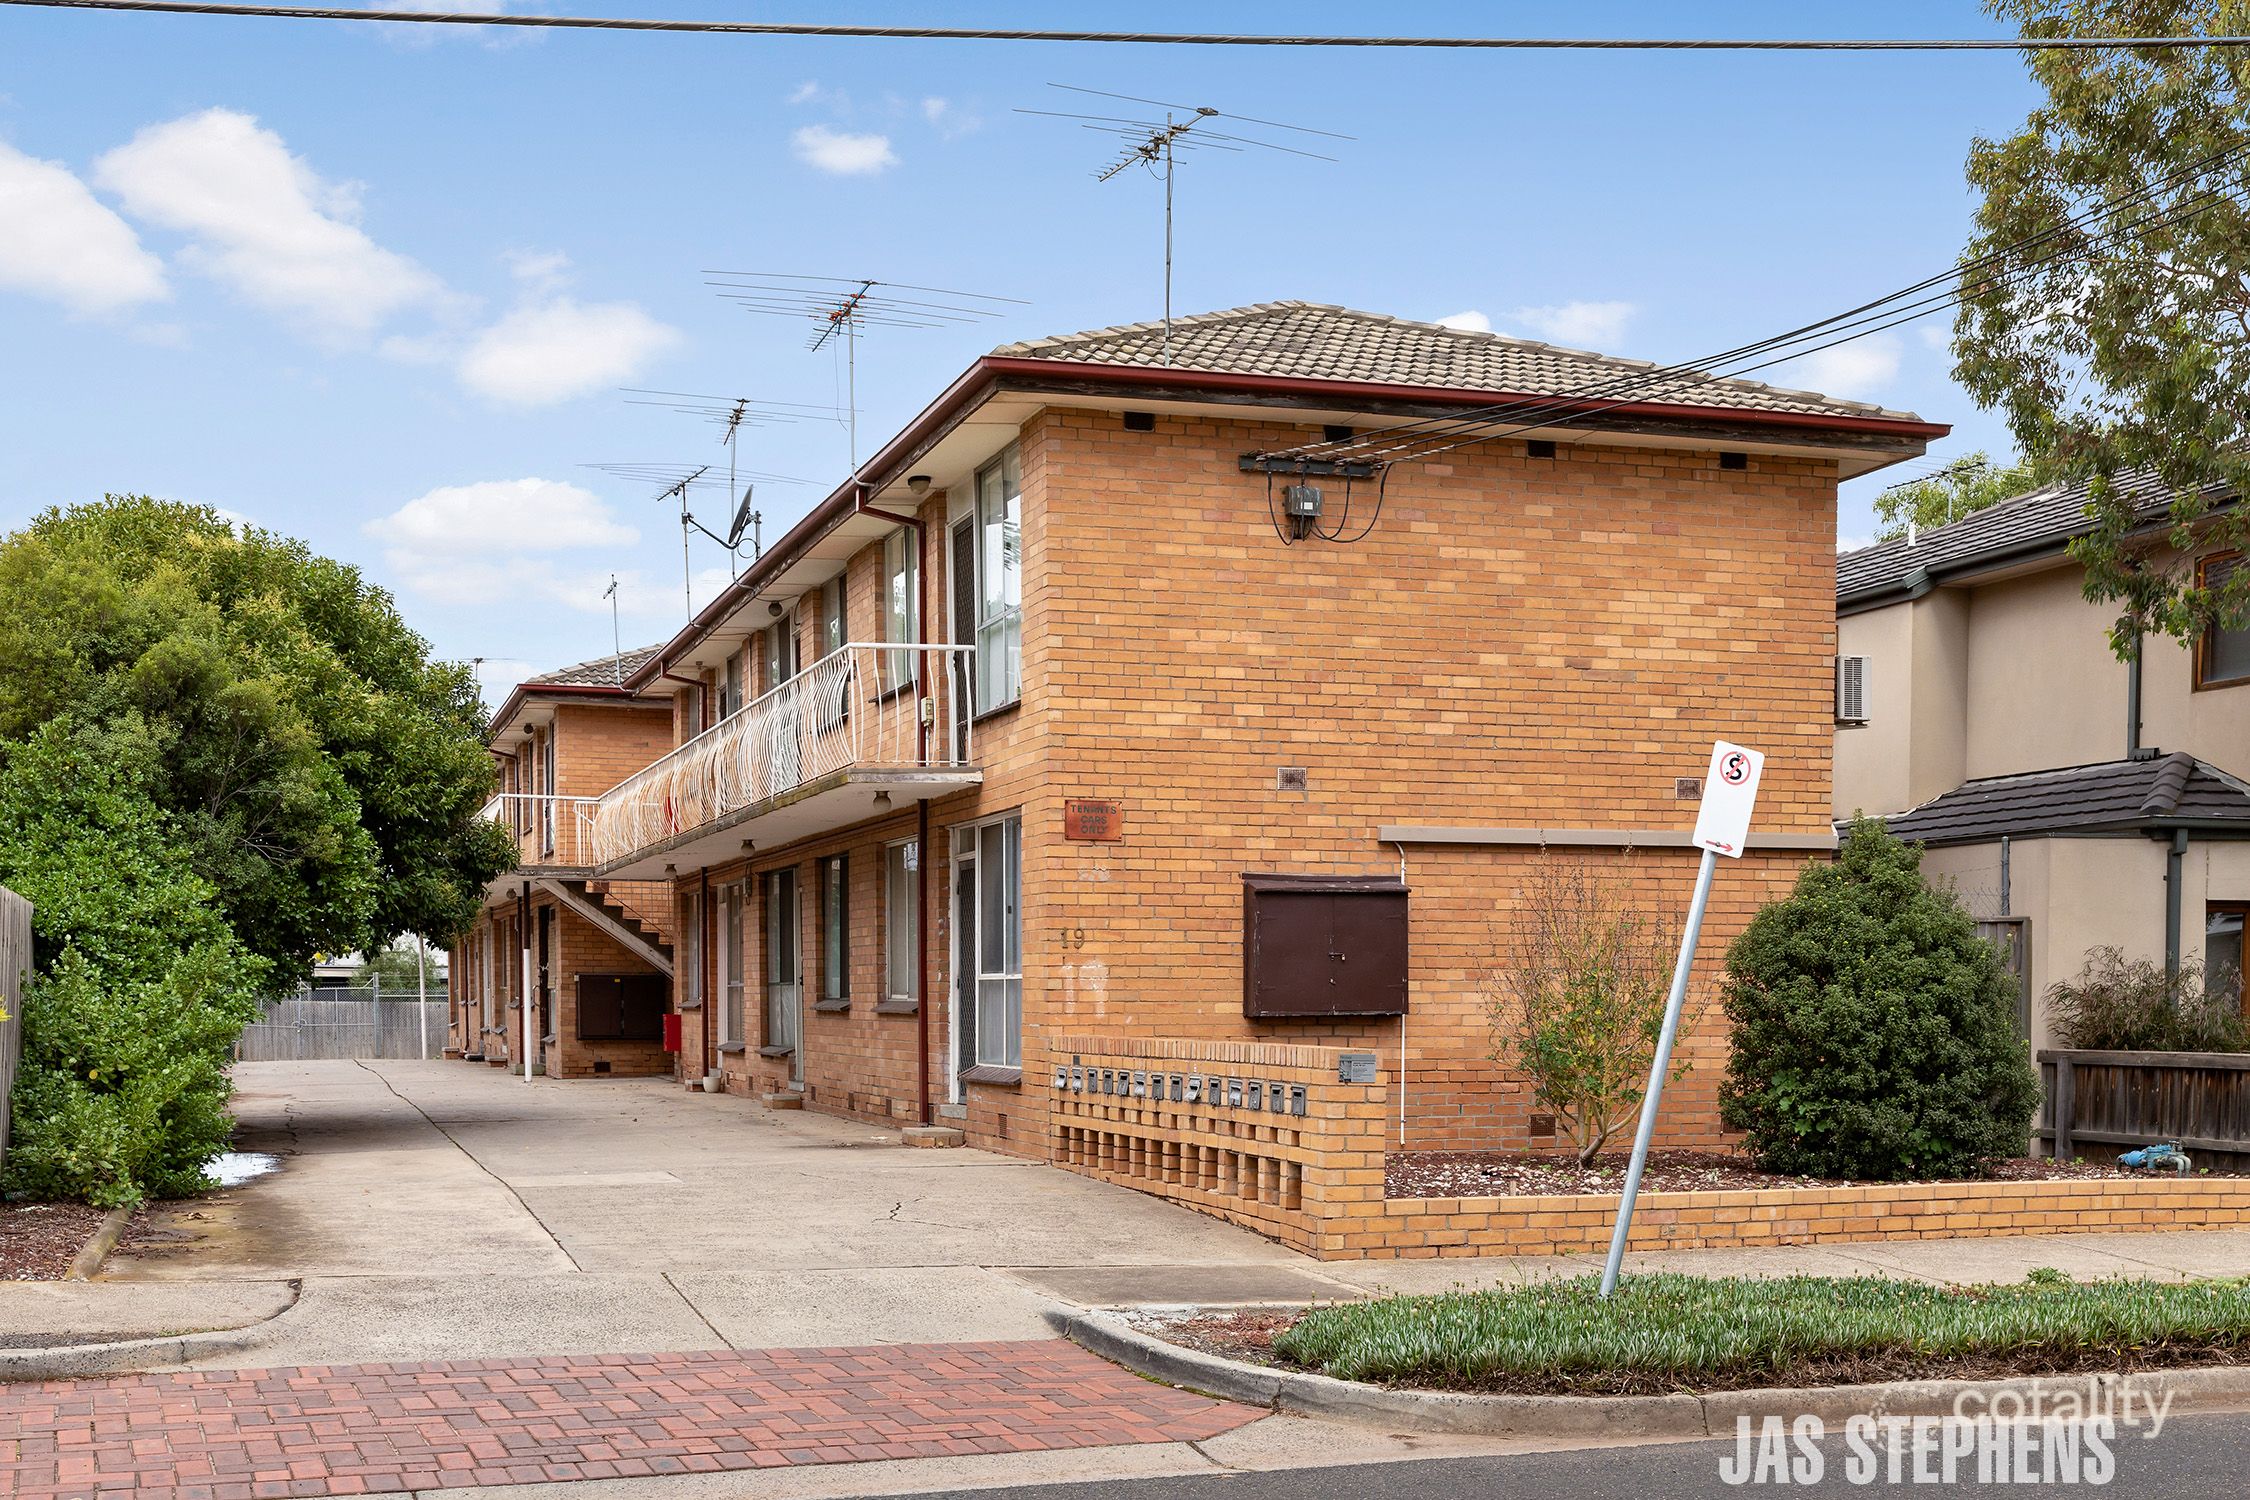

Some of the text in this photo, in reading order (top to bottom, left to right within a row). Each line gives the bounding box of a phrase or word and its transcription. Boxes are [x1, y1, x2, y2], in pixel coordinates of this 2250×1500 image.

[1725, 757, 1744, 780] S
[1070, 804, 1117, 814] TENANTS
[1080, 815, 1108, 824] CARS
[1080, 825, 1108, 834] ONLY
[1061, 927, 1085, 949] 19
